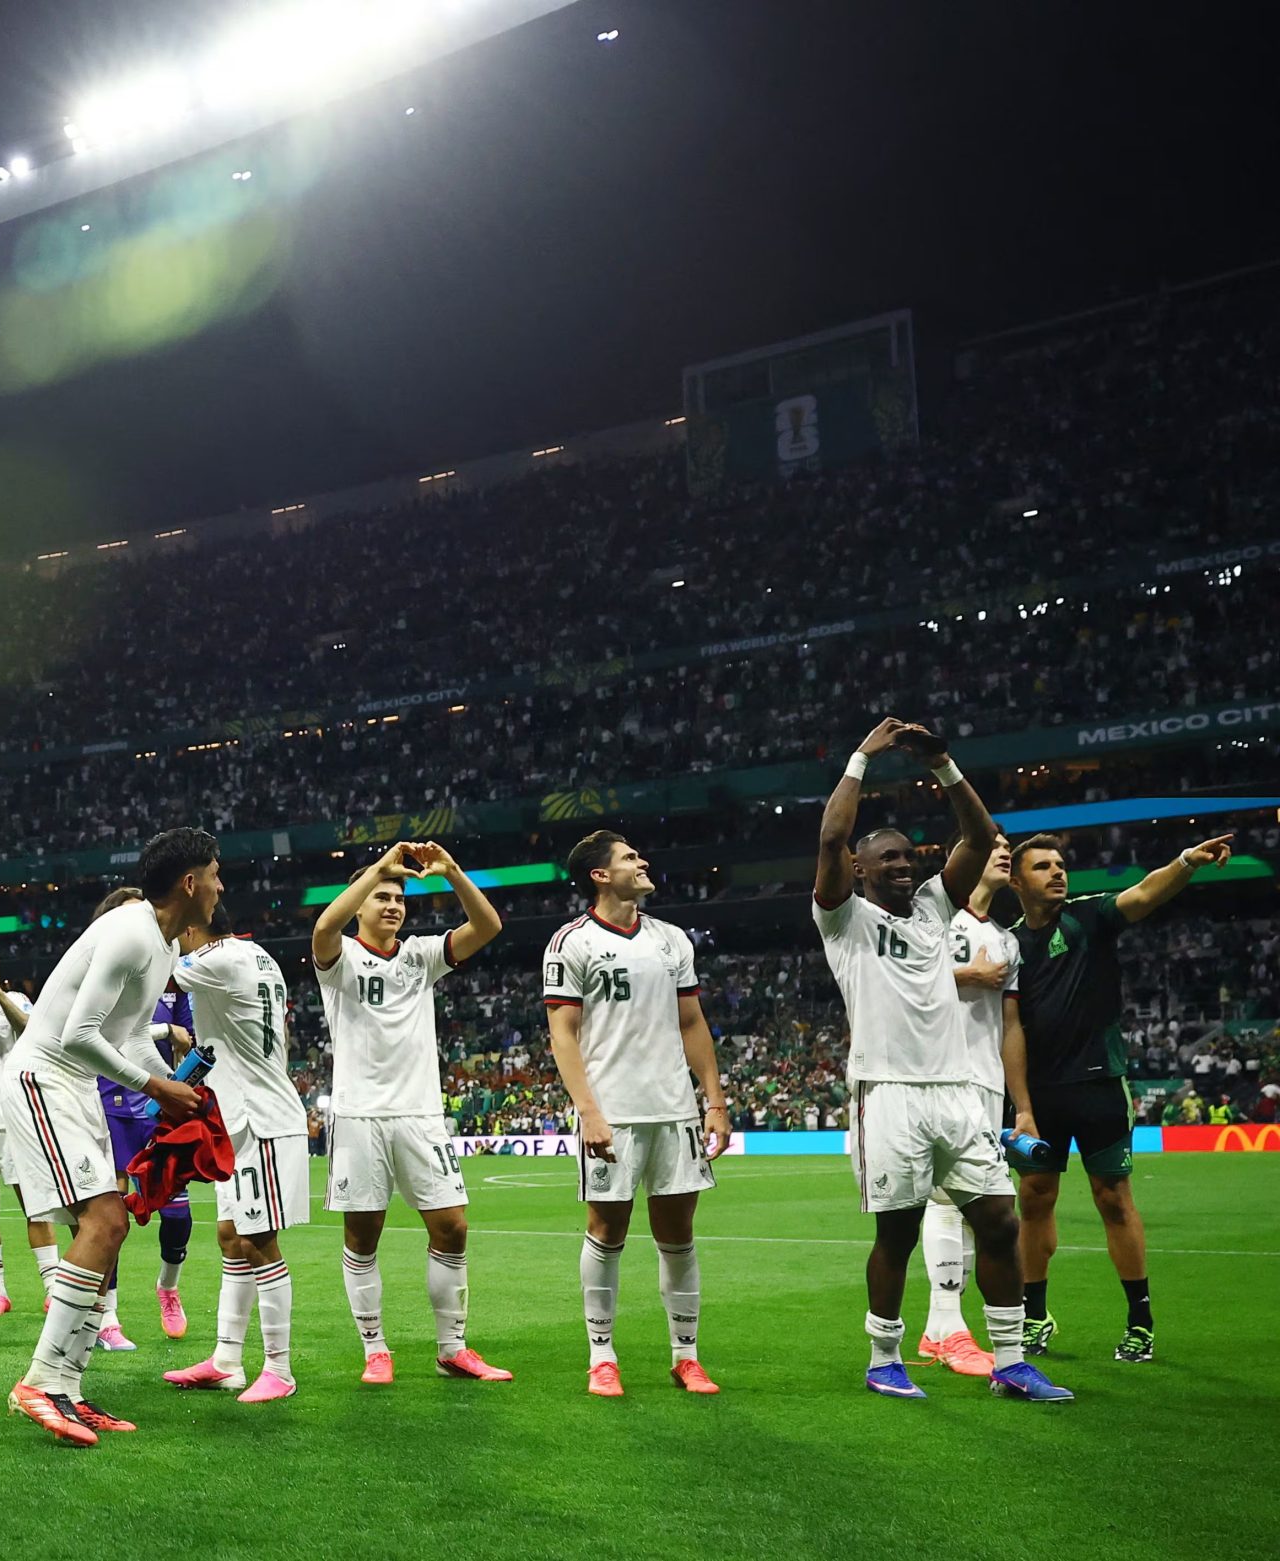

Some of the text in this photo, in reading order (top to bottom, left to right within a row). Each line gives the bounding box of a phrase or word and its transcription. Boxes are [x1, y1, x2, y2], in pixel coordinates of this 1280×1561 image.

[700, 644, 728, 656] FIFA
[730, 635, 777, 652] WORLD
[807, 620, 855, 639] 2026
[358, 688, 467, 713] MEXICO CITY
[1078, 704, 1280, 745] MEXICO CIT
[877, 924, 909, 959] 16
[954, 934, 971, 963] 3
[357, 975, 384, 1006] 18
[599, 968, 631, 1003] 15
[433, 1143, 460, 1176] 18
